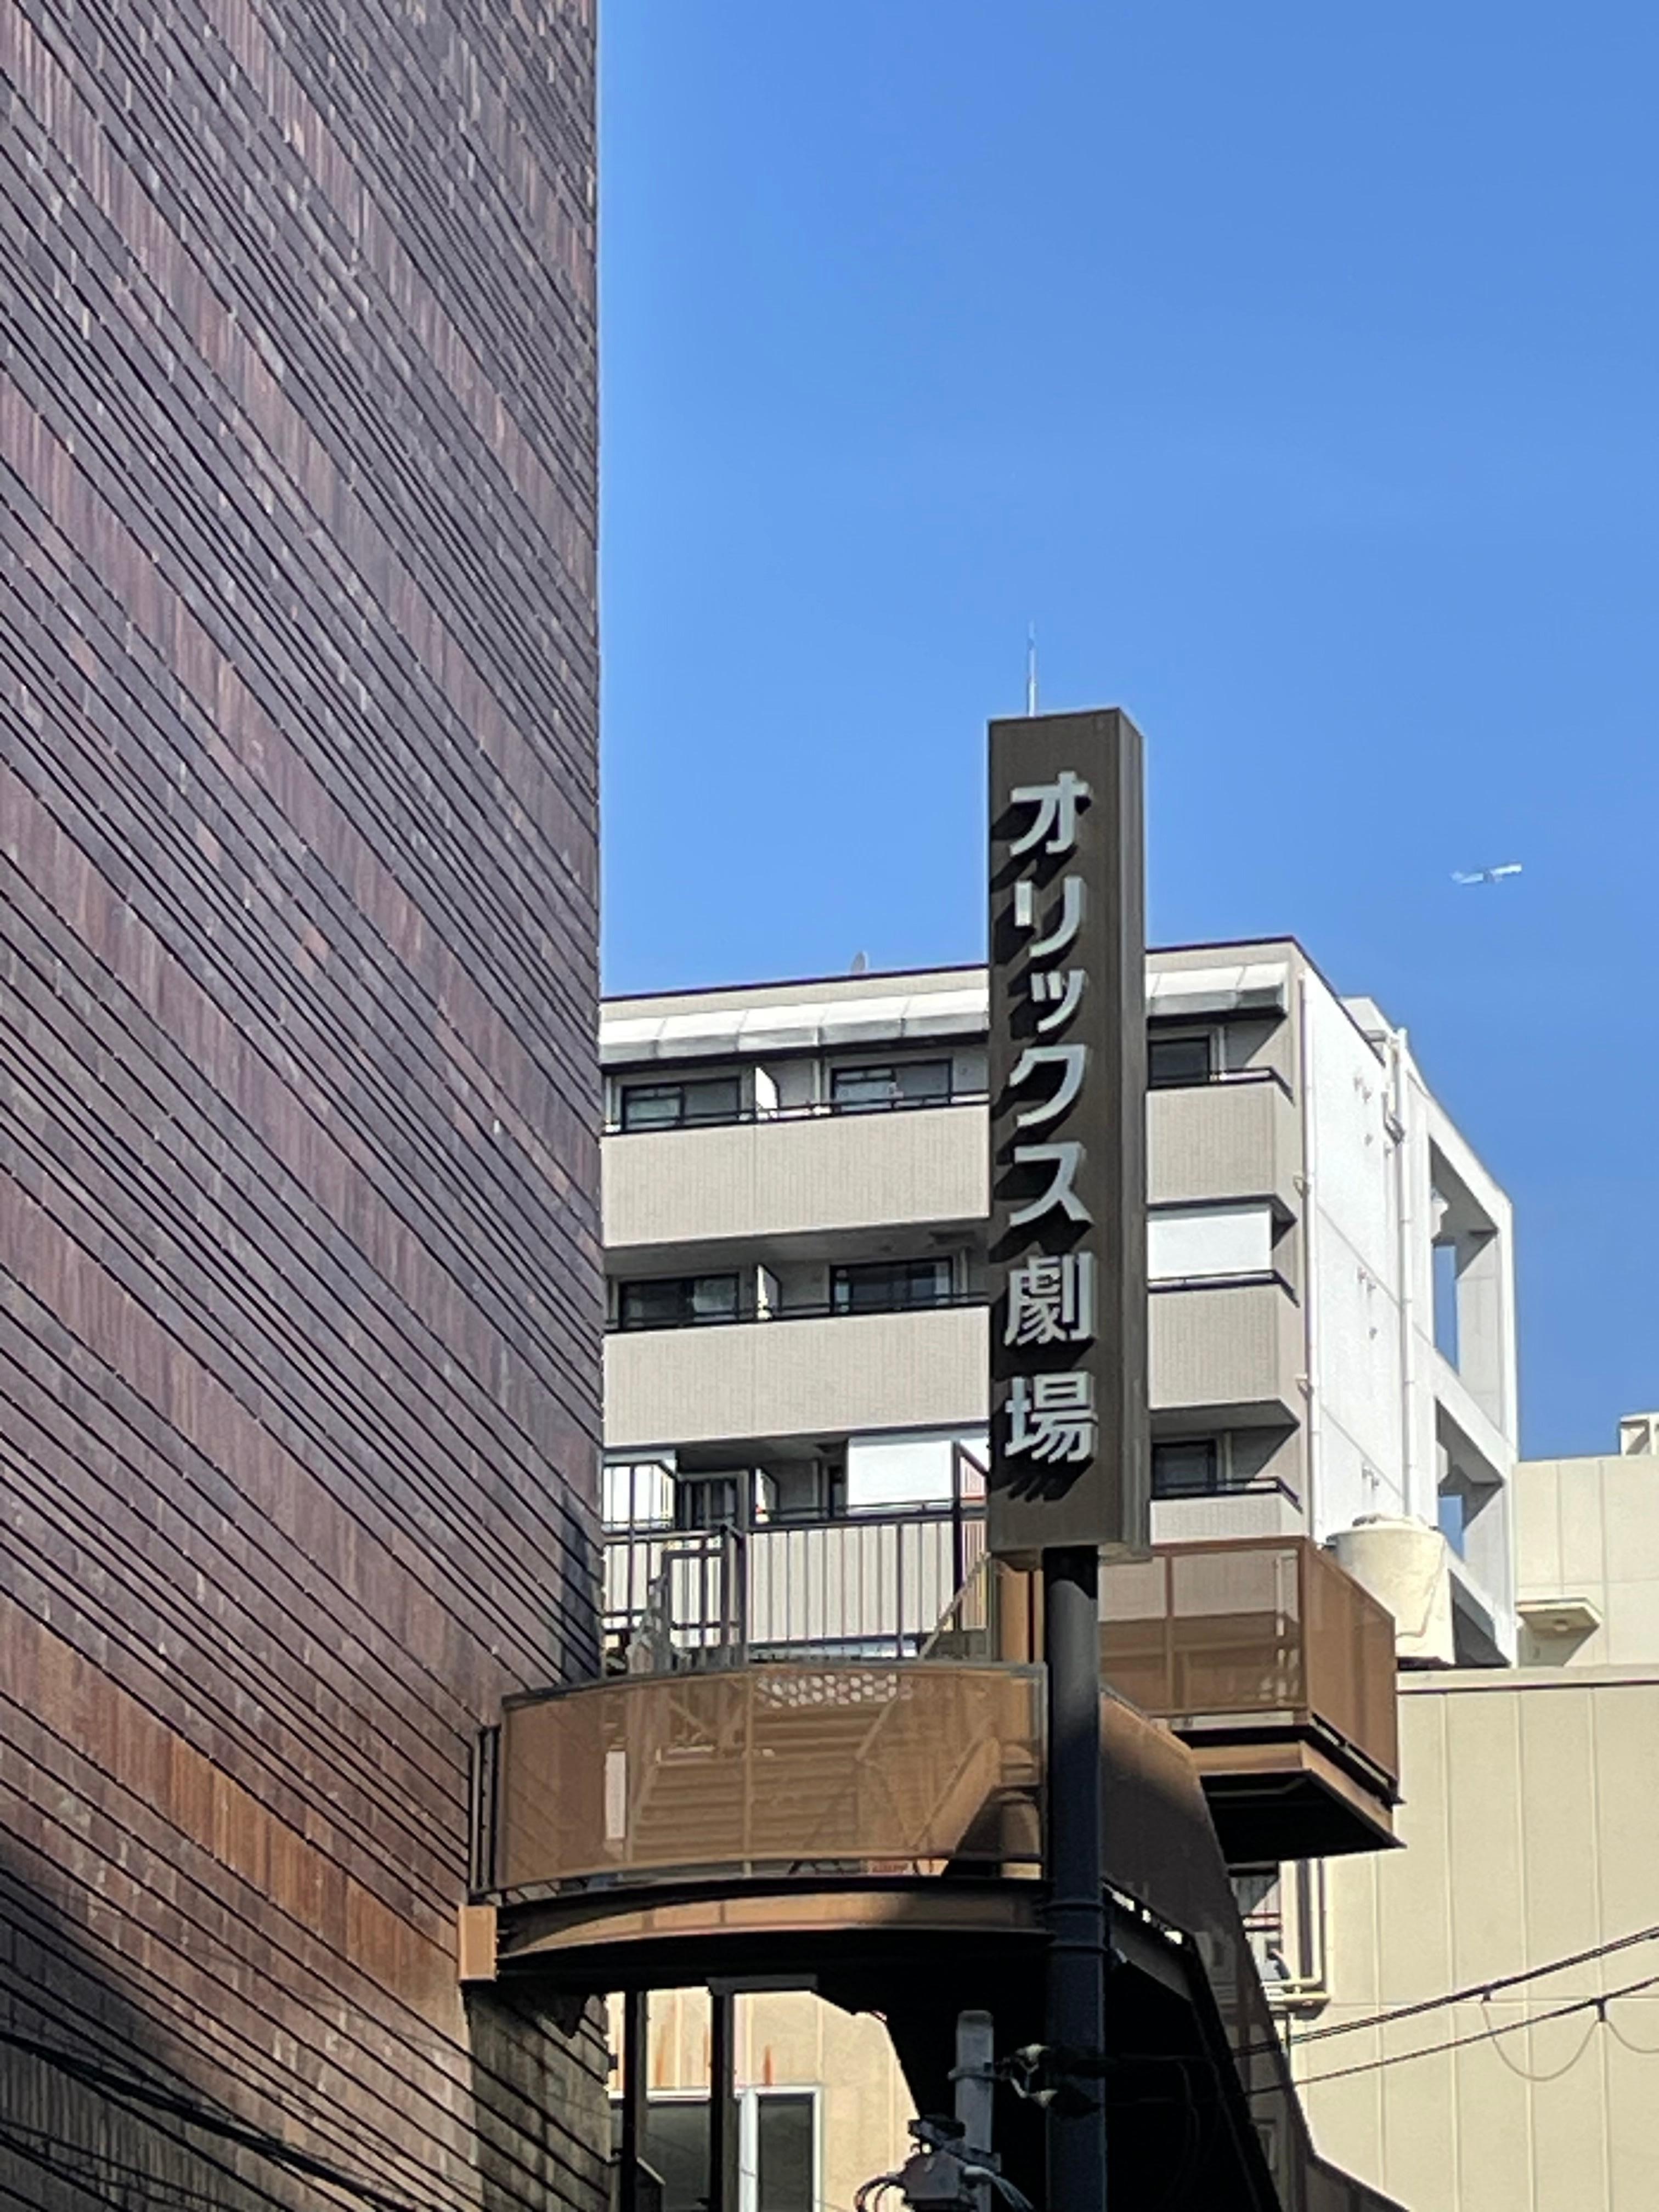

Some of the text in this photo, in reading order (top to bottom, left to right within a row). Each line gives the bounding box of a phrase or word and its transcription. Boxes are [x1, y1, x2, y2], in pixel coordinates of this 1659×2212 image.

[1003, 770, 1097, 1464] オリックス劇場
